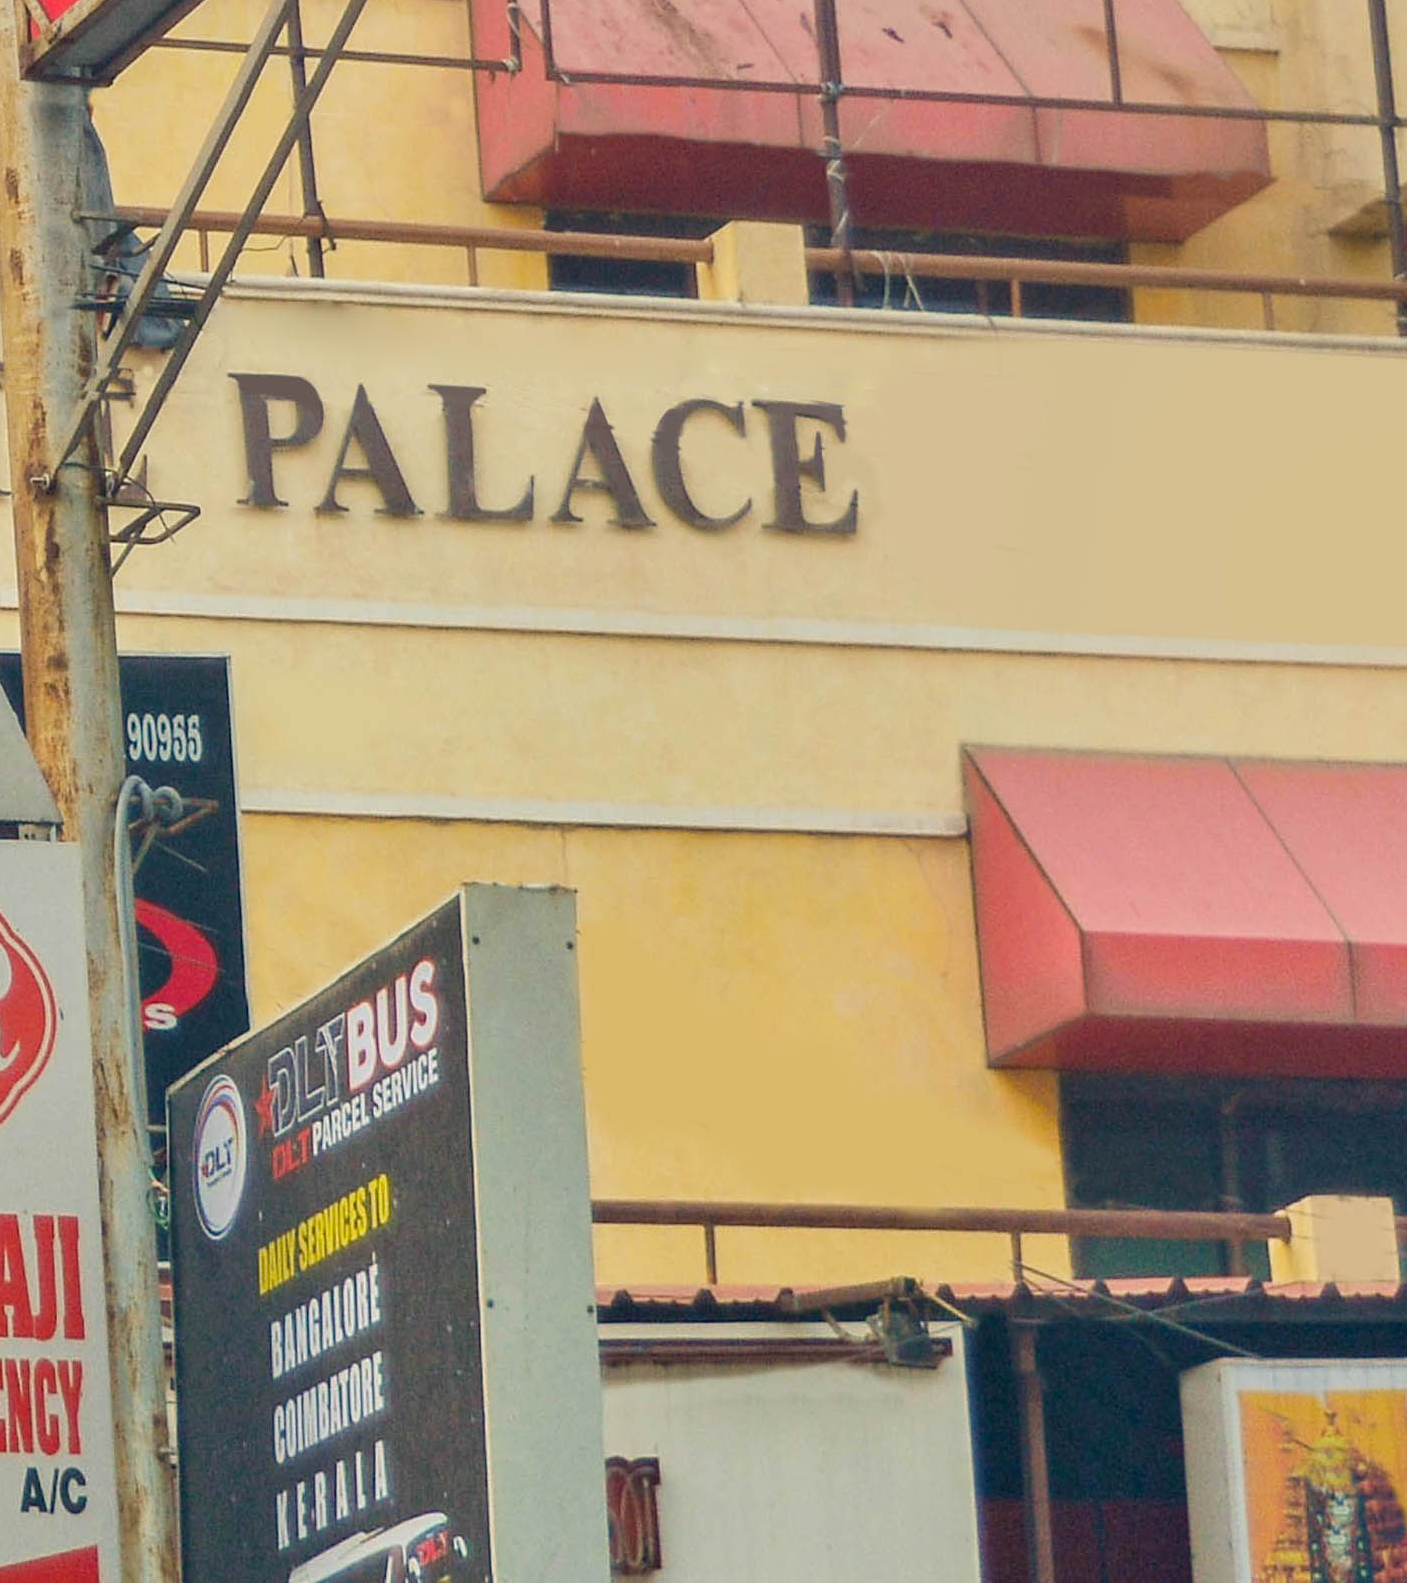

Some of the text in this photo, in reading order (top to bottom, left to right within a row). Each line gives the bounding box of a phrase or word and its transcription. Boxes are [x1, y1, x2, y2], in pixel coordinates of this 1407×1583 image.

[229, 371, 860, 537] PALACE
[127, 712, 203, 762] 90955
[312, 1091, 370, 1157] PARCEL
[372, 1047, 439, 1119] SERVICE
[258, 1172, 391, 1297] DAILY SERVICES TO
[270, 1262, 382, 1380] BANGALORE
[273, 1350, 386, 1465] COIMBATORE
[19, 1466, 87, 1515] A/C
[275, 1438, 389, 1552] KERALA
